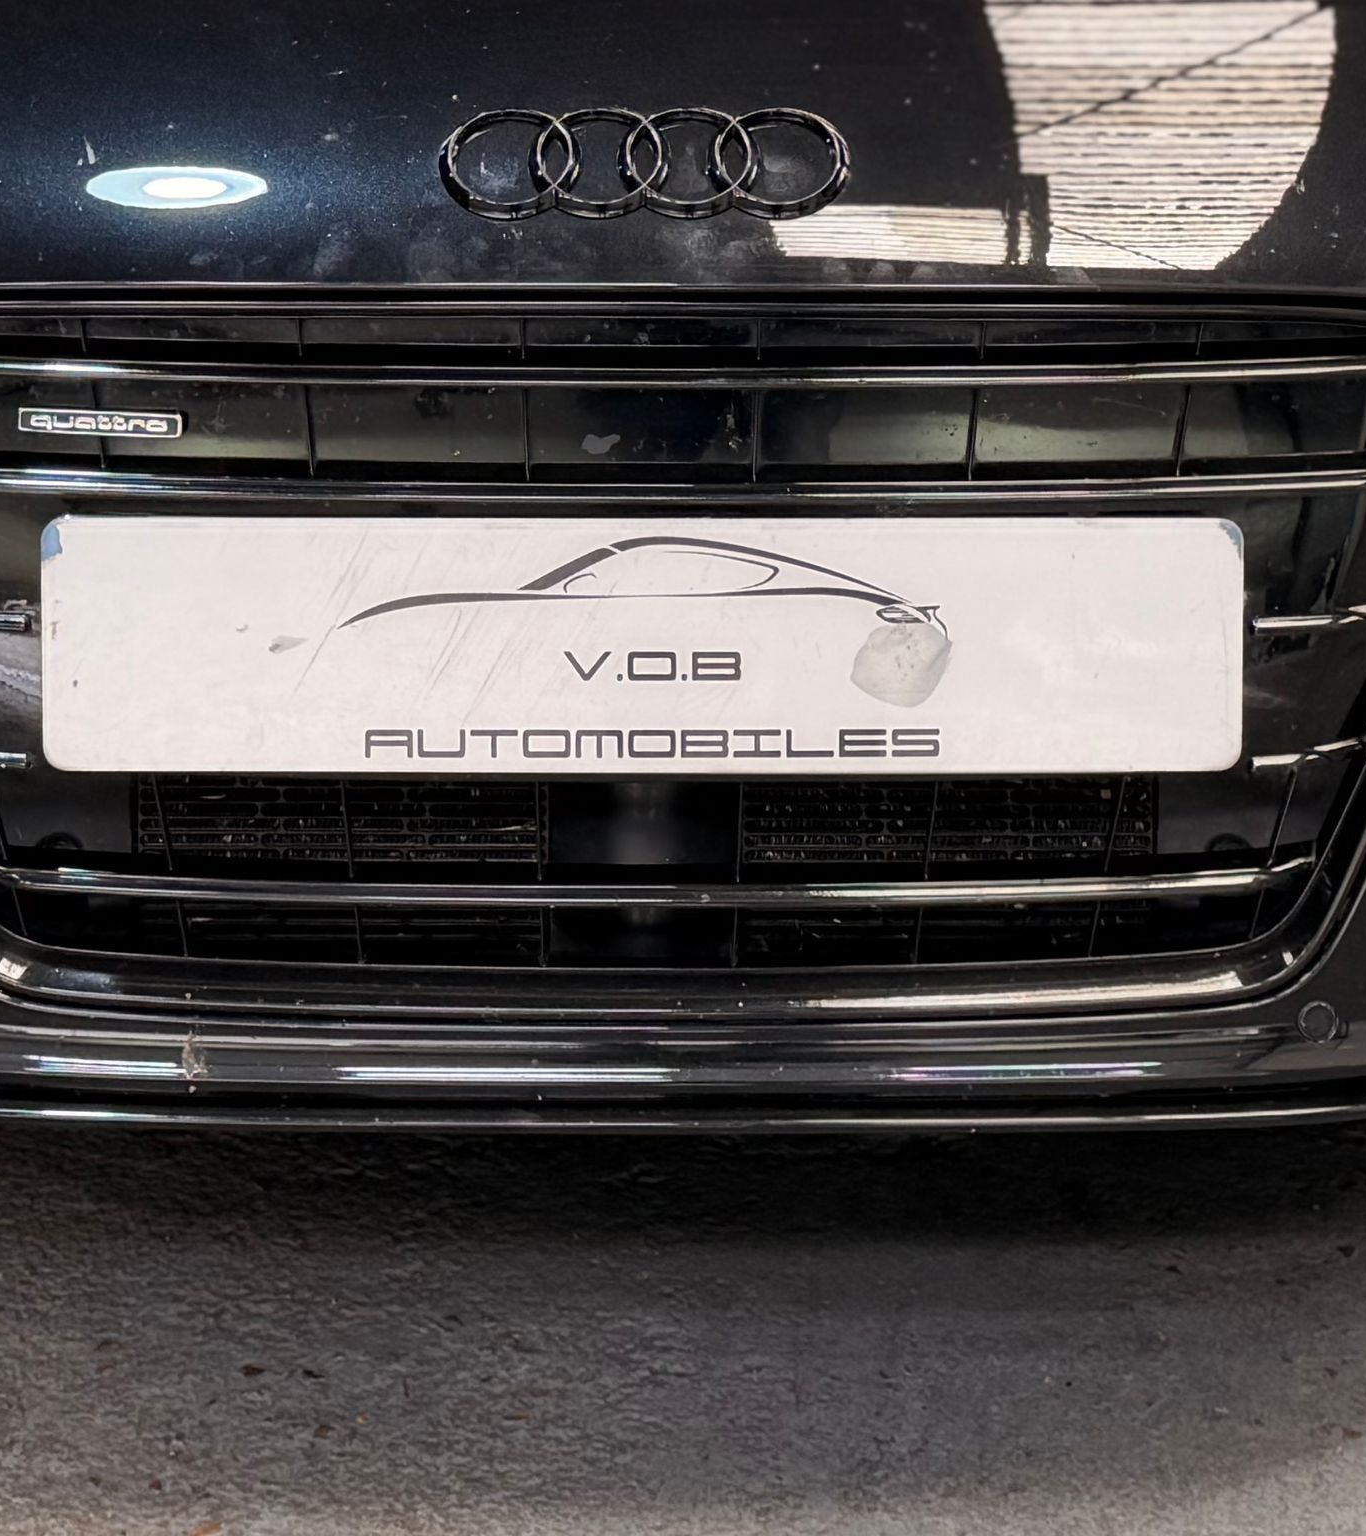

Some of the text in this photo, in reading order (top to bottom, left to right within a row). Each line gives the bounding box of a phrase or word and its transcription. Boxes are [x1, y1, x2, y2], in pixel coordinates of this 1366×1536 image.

[30, 414, 168, 432] quattro
[564, 651, 742, 682] V.O.B
[364, 727, 941, 759] AUTOMOBILES
